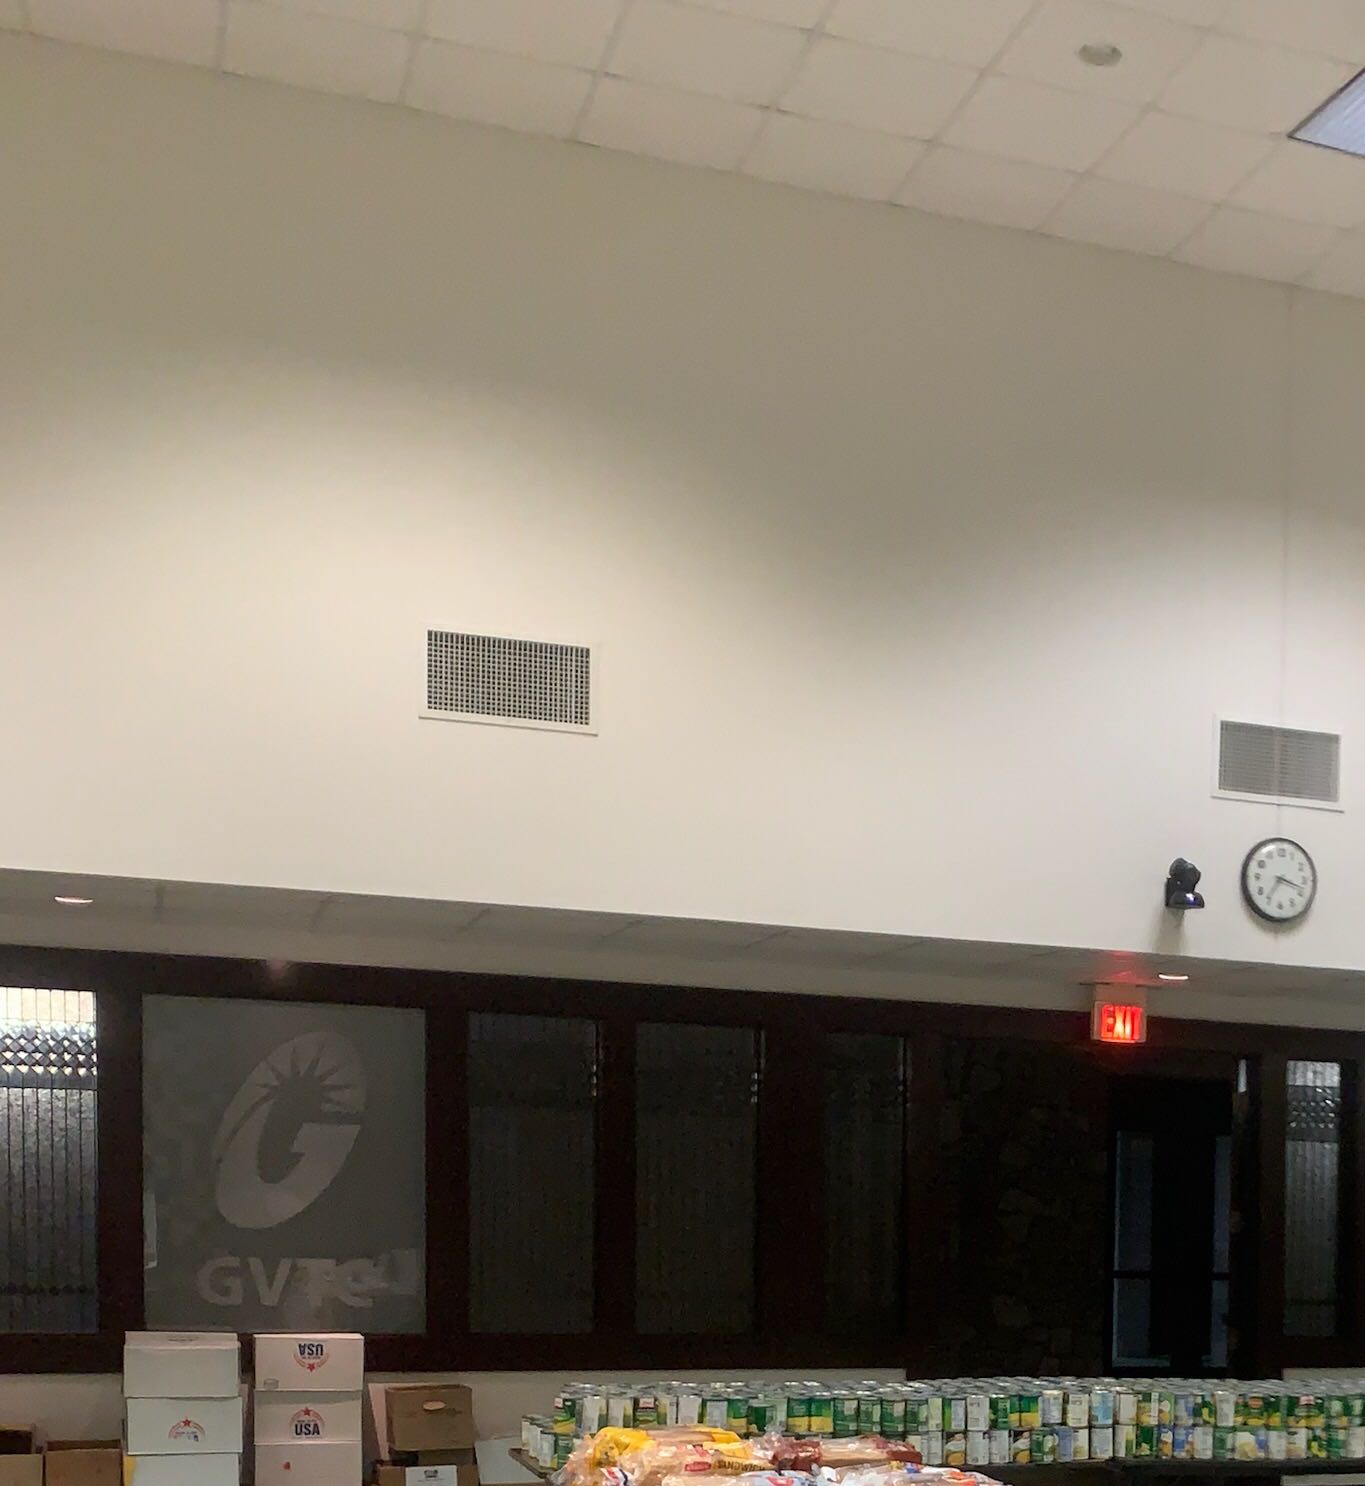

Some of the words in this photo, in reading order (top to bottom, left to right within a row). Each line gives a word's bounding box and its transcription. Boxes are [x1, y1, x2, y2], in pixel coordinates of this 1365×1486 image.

[1101, 1004, 1142, 1039] EXIT
[196, 1256, 373, 1308] GVTC
[298, 1343, 324, 1357] USA
[295, 1423, 320, 1436] USA
